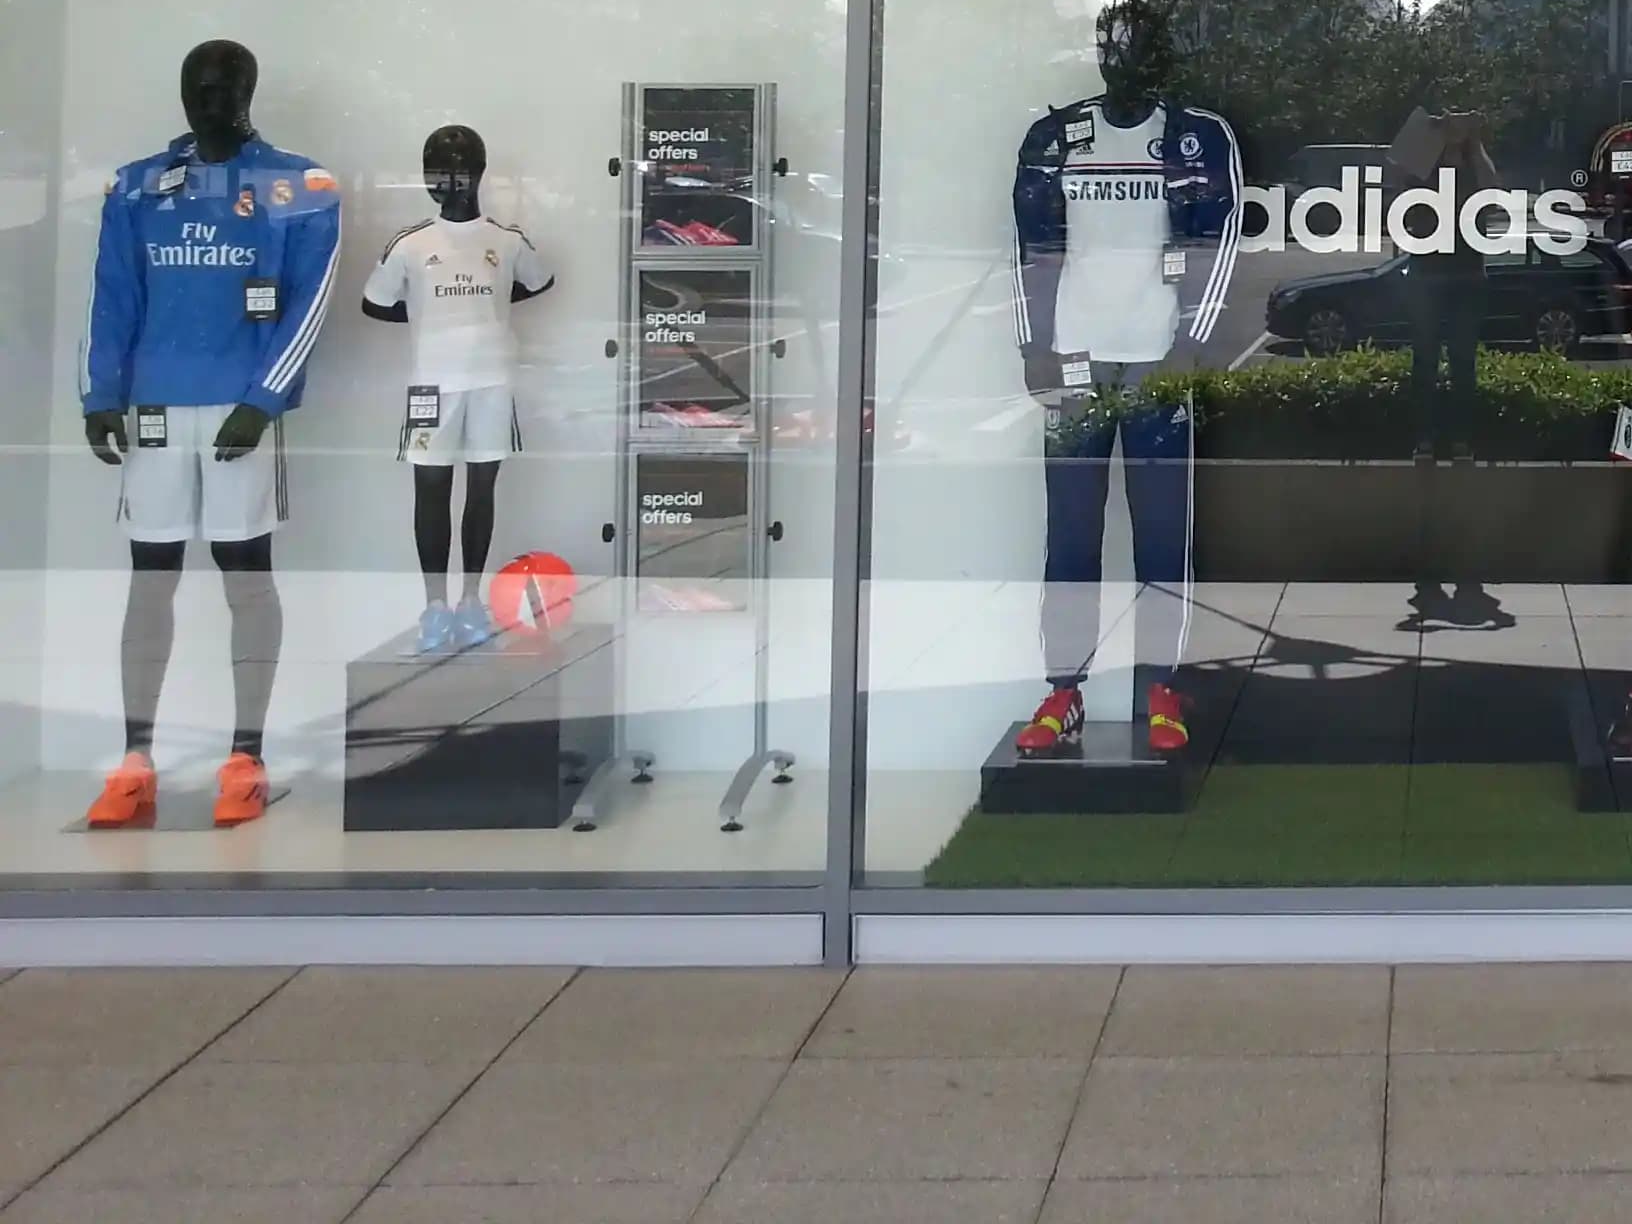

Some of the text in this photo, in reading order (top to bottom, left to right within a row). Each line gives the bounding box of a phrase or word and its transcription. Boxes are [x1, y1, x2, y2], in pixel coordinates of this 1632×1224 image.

[648, 127, 709, 145] special
[648, 145, 699, 160] offers
[1238, 165, 1588, 257] adidas
[181, 222, 217, 243] Fly
[146, 242, 257, 267] Emirates
[455, 273, 473, 284] Fly
[434, 283, 494, 298] Emirates
[645, 310, 706, 327] special
[645, 328, 696, 343] offers
[642, 491, 703, 509] special
[642, 510, 693, 525] offers
